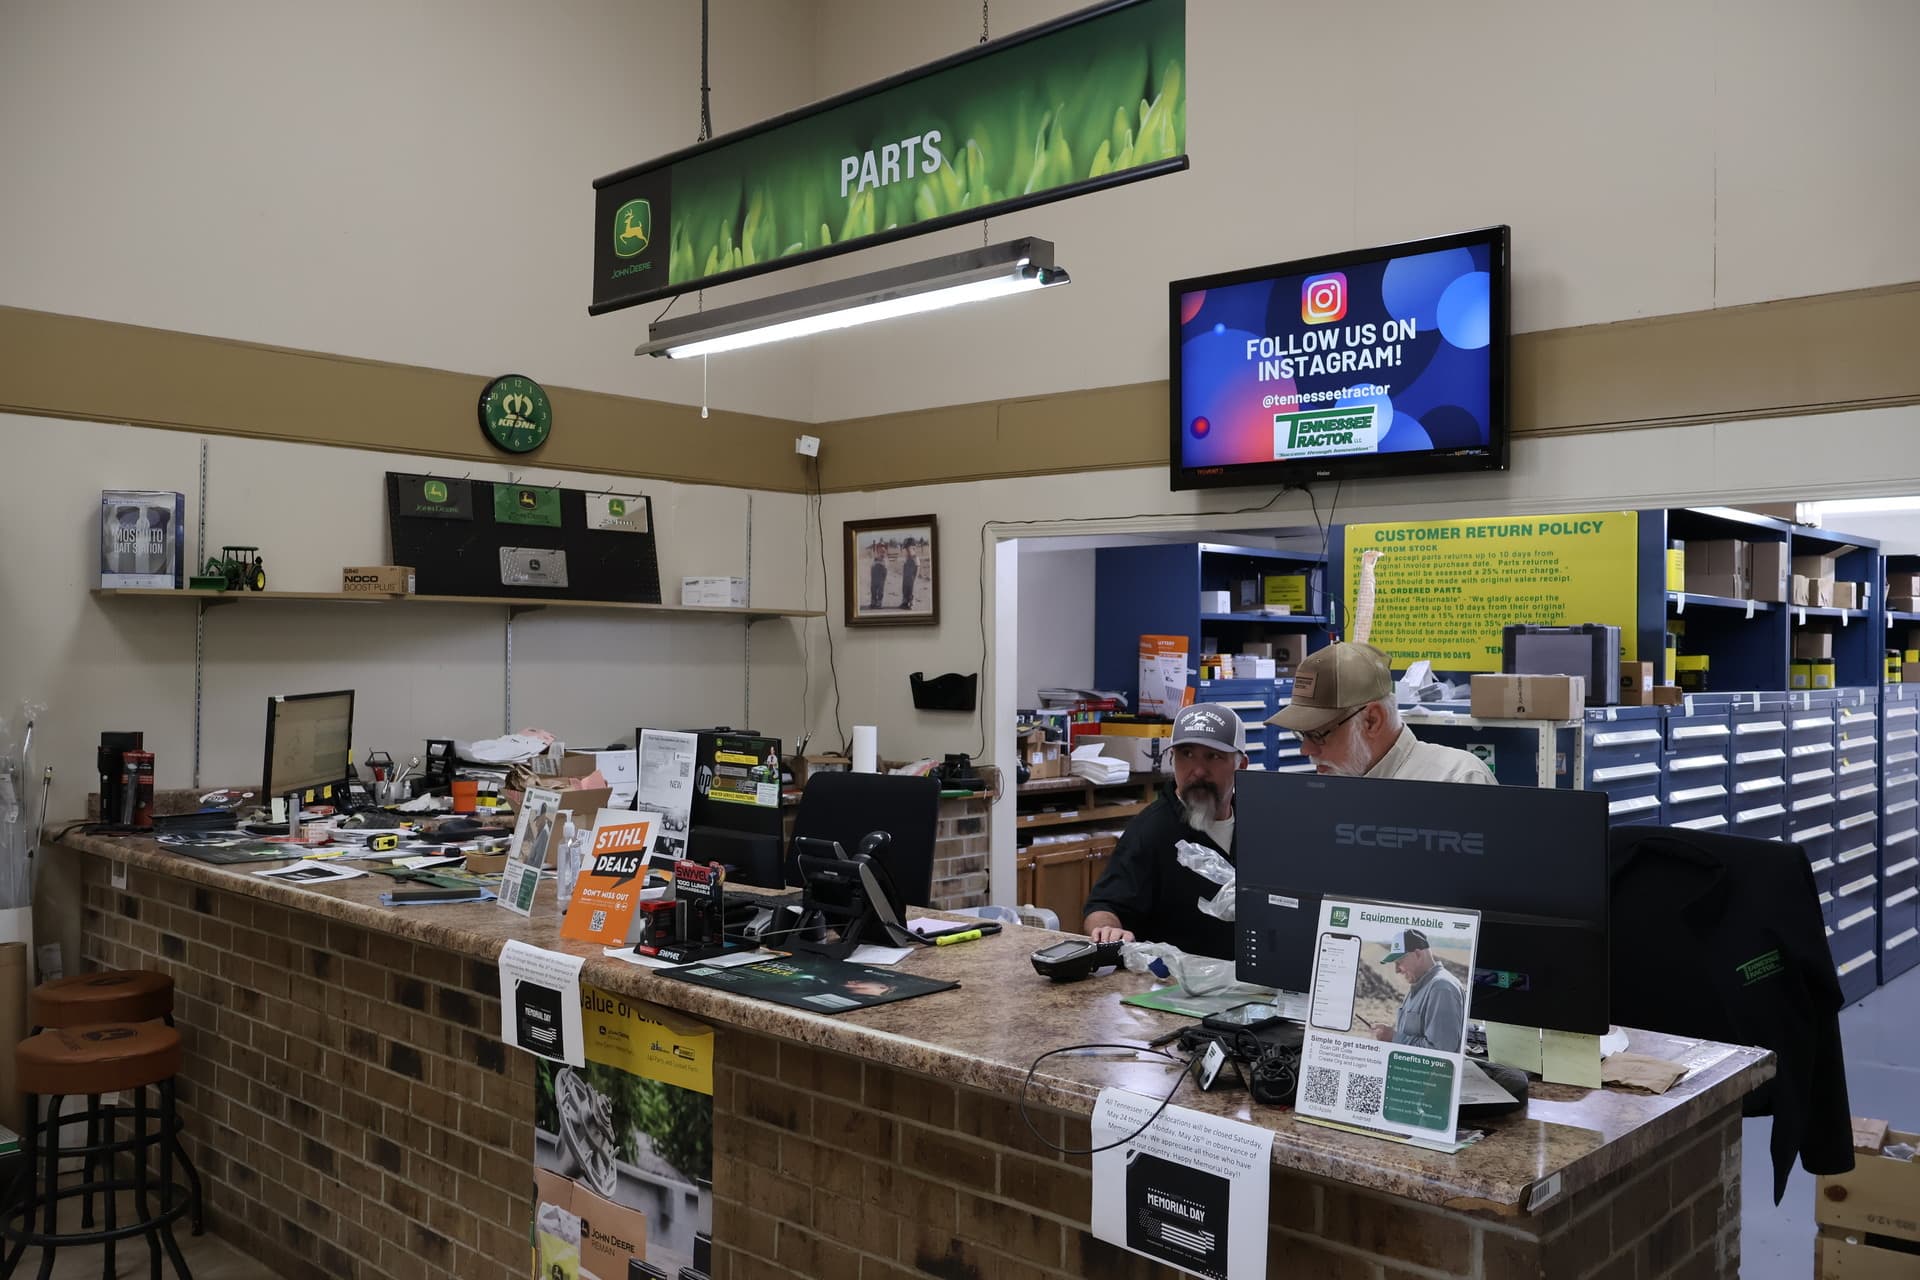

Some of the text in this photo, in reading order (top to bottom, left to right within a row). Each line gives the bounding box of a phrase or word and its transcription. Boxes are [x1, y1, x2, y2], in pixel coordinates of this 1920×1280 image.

[841, 130, 942, 198] PARTS
[1246, 318, 1416, 360] FOLLOW US ON
[1258, 344, 1402, 382] INSTAGRAM!
[1262, 384, 1391, 408] @tennesseetractor
[1276, 406, 1375, 438] TENNESSEE
[1375, 520, 1604, 542] CUSTOMER RETURN POLICY
[1382, 544, 1438, 553] FROM STOCK
[1395, 553, 1421, 562] accept
[1422, 552, 1441, 561] parts
[1444, 552, 1472, 560] returns
[1476, 552, 1486, 561] up
[1512, 551, 1531, 560] days
[1404, 561, 1431, 569] invoice
[1433, 561, 1469, 570] purchase
[1523, 558, 1559, 566] returned
[1424, 569, 1432, 577] be
[1436, 569, 1472, 577] assessed
[1482, 567, 1498, 575] 25%
[1502, 567, 1527, 575] return
[344, 575, 378, 583] NOCO
[344, 583, 395, 592] BOOST PLUS
[1396, 577, 1423, 585] Should
[1438, 576, 1458, 584] made
[1461, 575, 1477, 583] with
[1481, 575, 1511, 584] original
[1515, 574, 1536, 582] sales
[1410, 604, 1429, 612] parts
[1466, 603, 1485, 612] days
[1488, 602, 1507, 610] from
[1510, 602, 1529, 610] their
[1532, 602, 1566, 611] original
[1487, 594, 1512, 603] gladly
[1515, 594, 1543, 603] accept
[1389, 612, 1409, 620] along
[1439, 611, 1454, 619] 15%
[1484, 610, 1510, 619] charge
[1515, 610, 1532, 619] plus
[1384, 620, 1402, 629] days
[1445, 619, 1472, 628] charge
[1396, 626, 1477, 635] Should be made with
[1409, 636, 1425, 644] your
[1421, 650, 1471, 659] AFTER 90 DAYS
[596, 827, 641, 849] STIHL
[1335, 823, 1484, 855] SCEPTRE
[596, 855, 638, 873] DEALS
[582, 888, 629, 901] DON'T MISS OUT
[1360, 911, 1410, 926] Equipment
[1411, 916, 1444, 929] Mobile
[1310, 1035, 1333, 1045] Simple
[1343, 1040, 1354, 1049] get
[1355, 1042, 1381, 1052] started:
[1393, 1052, 1422, 1064] Benefits
[1431, 1060, 1446, 1068] you:
[1114, 1100, 1142, 1113] Tennessee
[1192, 1122, 1204, 1131] will
[1204, 1125, 1211, 1133] be
[1213, 1128, 1232, 1140] closed
[1106, 1110, 1119, 1119] May
[1120, 1112, 1127, 1121] 24
[1179, 1130, 1191, 1141] May
[1213, 1141, 1248, 1158] observance
[1249, 1151, 1257, 1160] of
[1137, 1142, 1146, 1150] our
[1173, 1153, 1192, 1165] Happy
[1193, 1157, 1222, 1173] Memorial
[1150, 1135, 1159, 1143] We
[1161, 1139, 1193, 1153] appreciate
[1203, 1149, 1220, 1160] those
[1221, 1156, 1234, 1165] who
[1236, 1160, 1251, 1170] have
[1147, 1193, 1205, 1223] MEMORIAL DAY
[591, 1228, 635, 1254] JOHN DEERE
